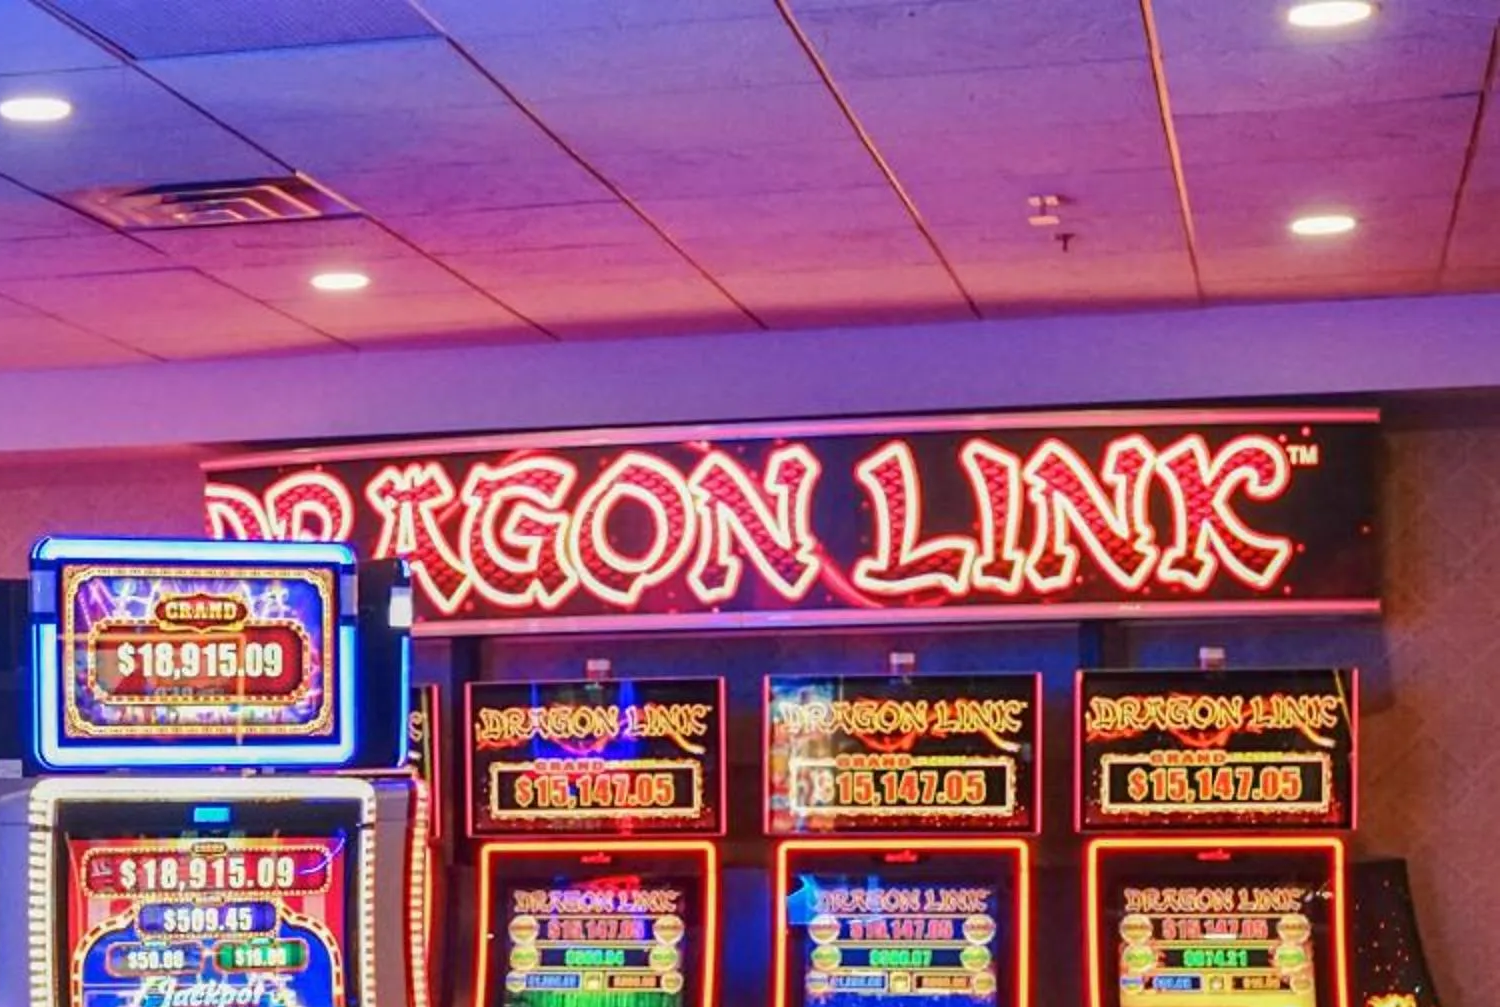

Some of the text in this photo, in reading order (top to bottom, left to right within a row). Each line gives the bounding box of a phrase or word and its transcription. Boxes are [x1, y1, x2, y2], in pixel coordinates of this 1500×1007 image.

[853, 434, 1293, 594] LINK
[164, 600, 238, 621] GRAND
[116, 640, 284, 679] $18,915.09
[479, 704, 620, 740] DRAGON
[780, 699, 929, 736] DRAGON
[1089, 694, 1338, 731] DRAGON LINK
[513, 773, 676, 809] $15,147.05
[1127, 765, 1303, 803] $15,147.05
[119, 856, 297, 892] $18,915.09
